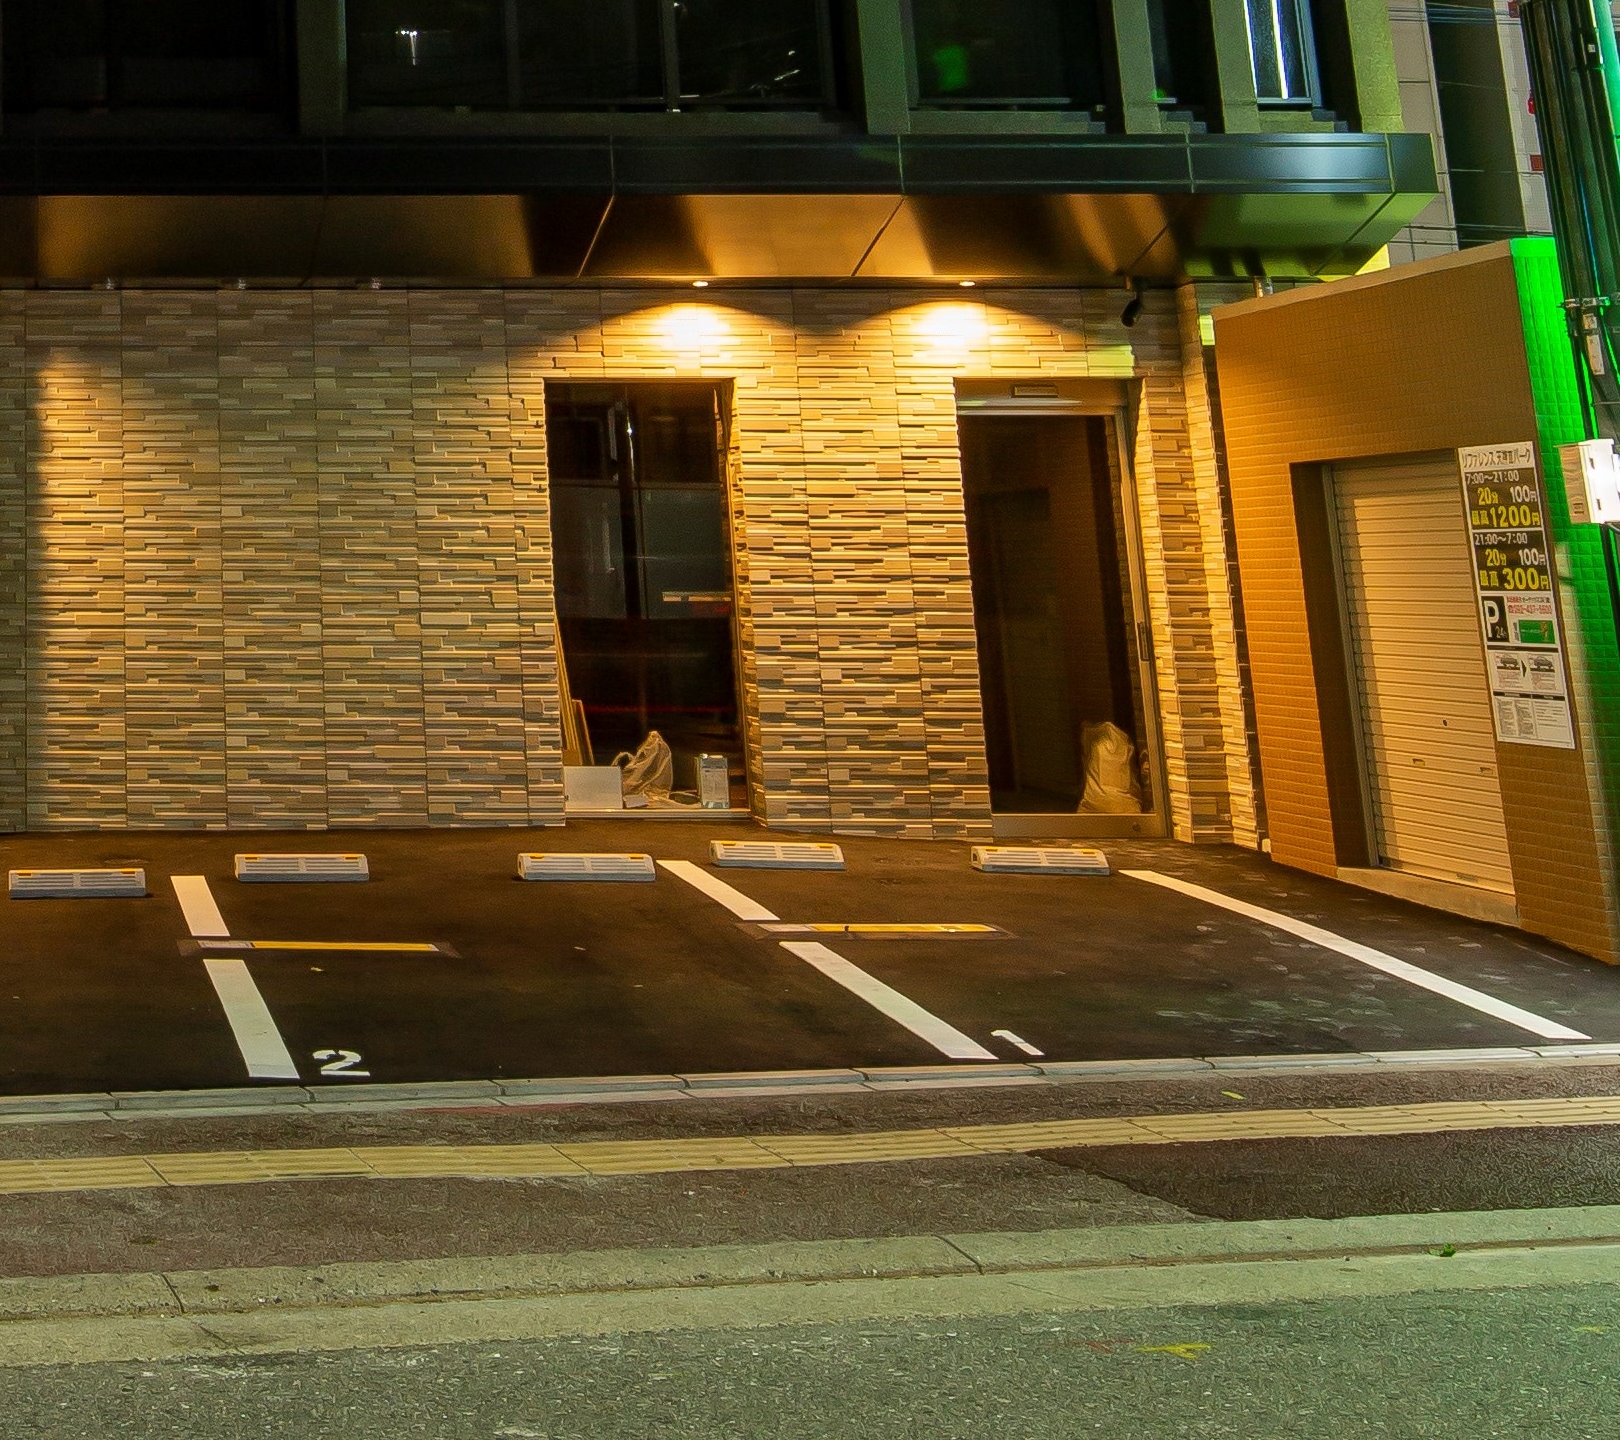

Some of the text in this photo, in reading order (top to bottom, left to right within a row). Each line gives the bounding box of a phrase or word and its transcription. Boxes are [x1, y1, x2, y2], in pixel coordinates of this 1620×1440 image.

[1478, 486, 1537, 505] 20分 100円
[1485, 548, 1546, 566] 20分 100円
[1484, 600, 1500, 638] P
[991, 1030, 1045, 1055] 1
[312, 1049, 371, 1076] 2
